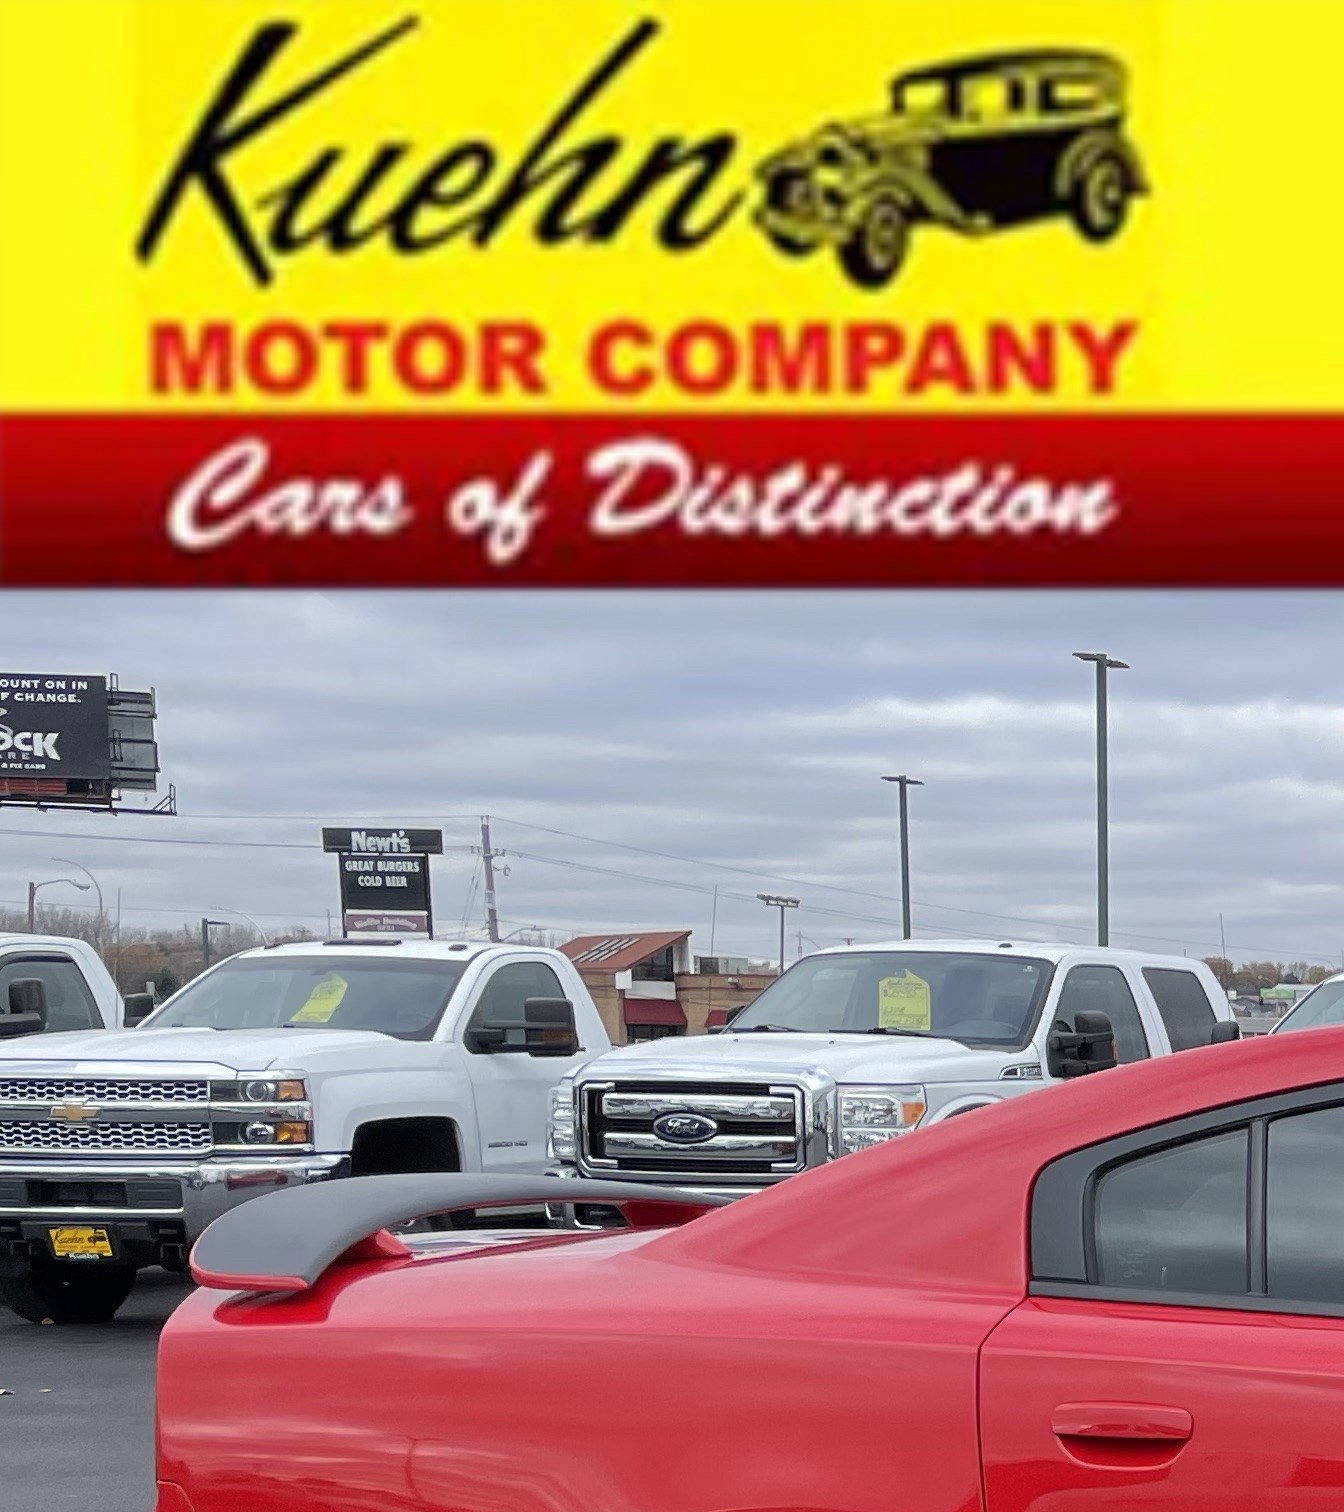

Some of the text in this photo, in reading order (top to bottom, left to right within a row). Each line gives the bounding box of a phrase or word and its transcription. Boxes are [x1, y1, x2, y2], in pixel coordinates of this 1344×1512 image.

[44, 680, 66, 690] ON
[71, 681, 88, 690] IN
[13, 692, 82, 703] CHANGE.
[351, 830, 411, 853] Newt's
[345, 860, 420, 873] GREAT BURGERS
[358, 875, 408, 887] COLD BEER
[665, 1118, 699, 1135] Ford
